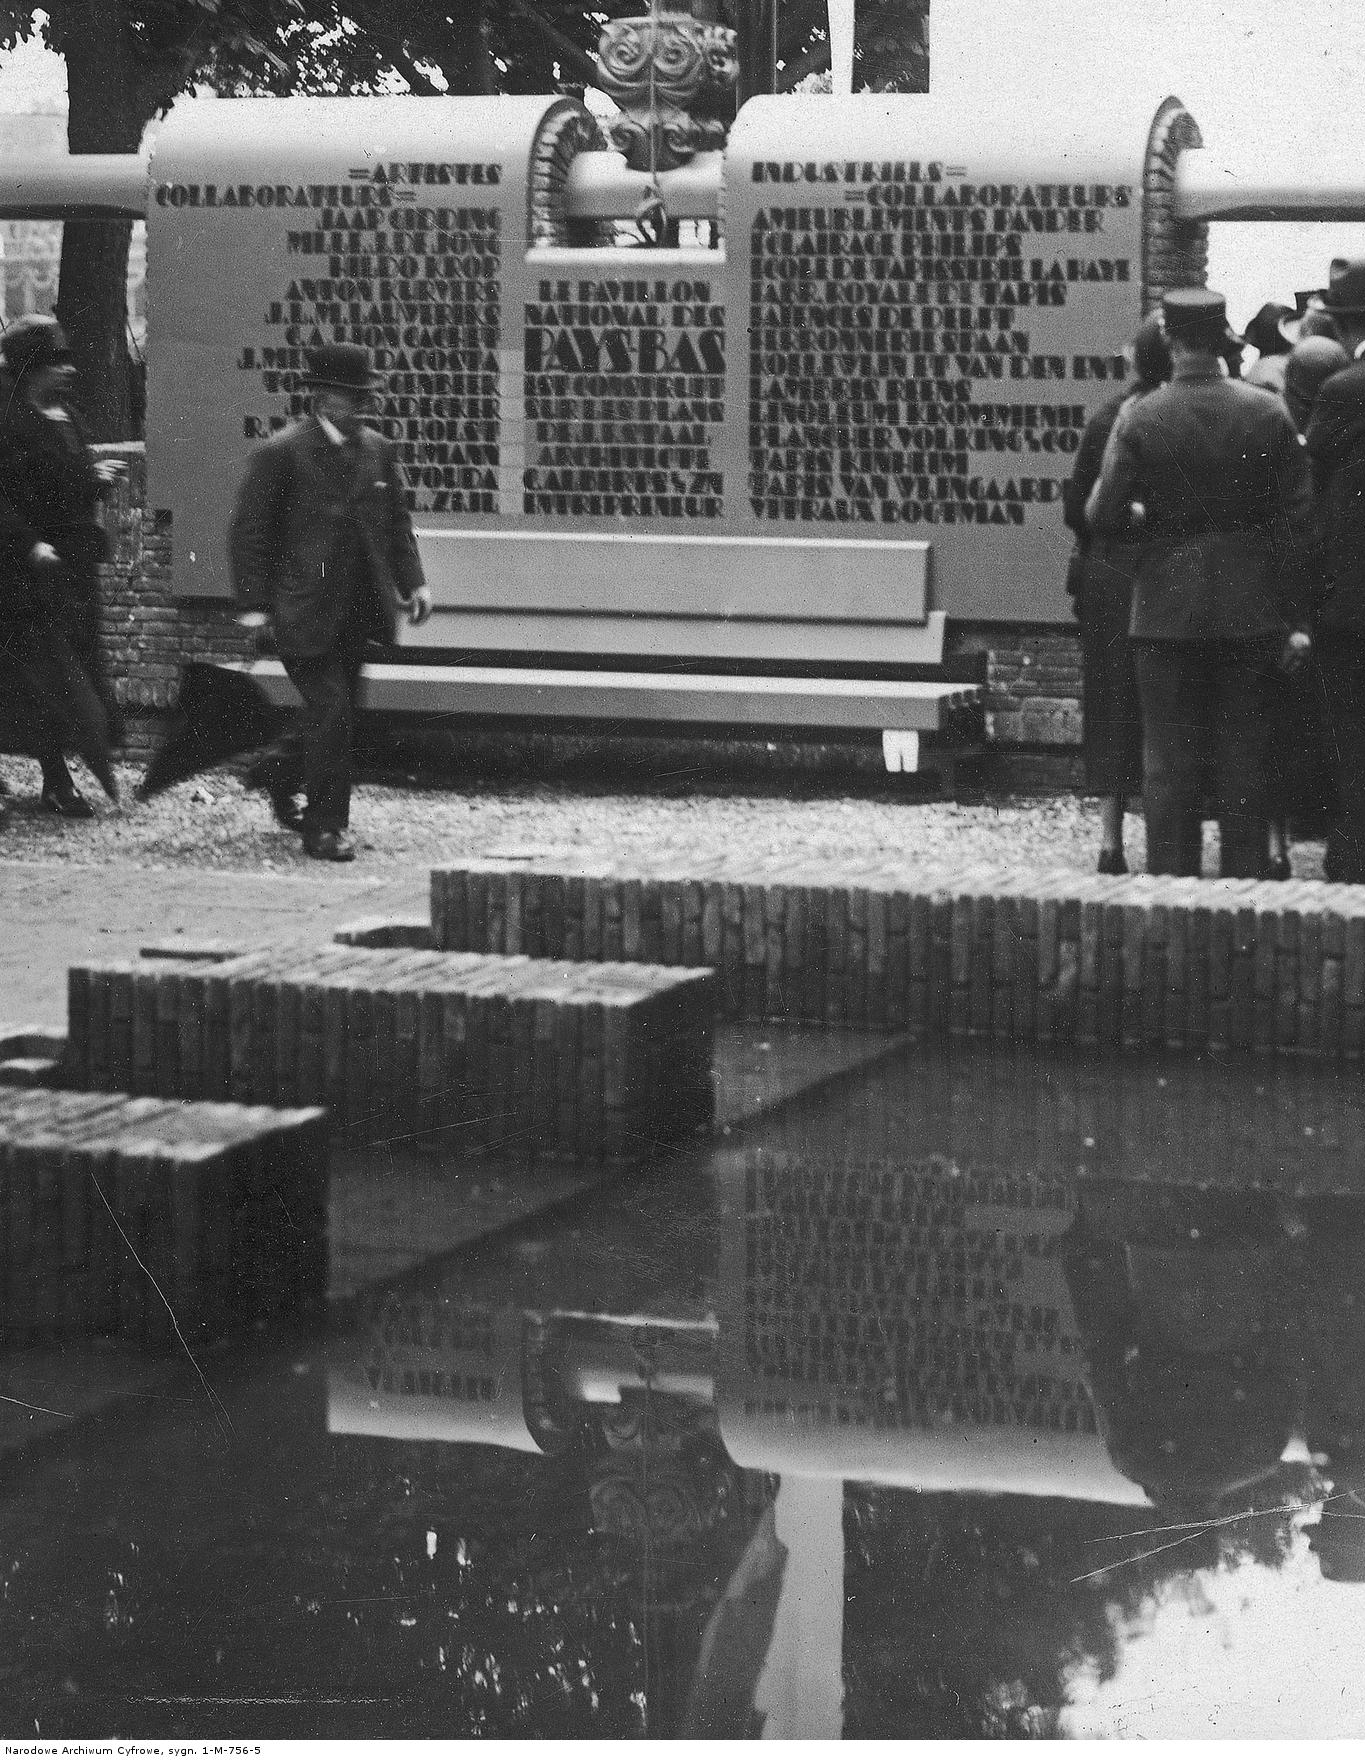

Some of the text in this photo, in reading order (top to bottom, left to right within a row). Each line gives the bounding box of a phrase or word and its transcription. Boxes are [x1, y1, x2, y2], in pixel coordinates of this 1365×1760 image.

[317, 208, 382, 230] JAAP
[752, 208, 985, 232] AMEUBLEMENTS
[900, 233, 1021, 257] PHILIPS
[330, 256, 500, 278] HILDO KROP
[284, 280, 372, 301] ANTON
[540, 280, 710, 303] LE PAVILLON
[979, 283, 1067, 307] TAPIS
[524, 305, 724, 329] NATIONAL DES
[919, 306, 1015, 331] DELFT
[524, 328, 725, 374] PAYS-BAS
[637, 400, 724, 423] PLANS
[536, 446, 708, 470] ARCHITECTE
[523, 493, 724, 518] ENTREPRENEUR
